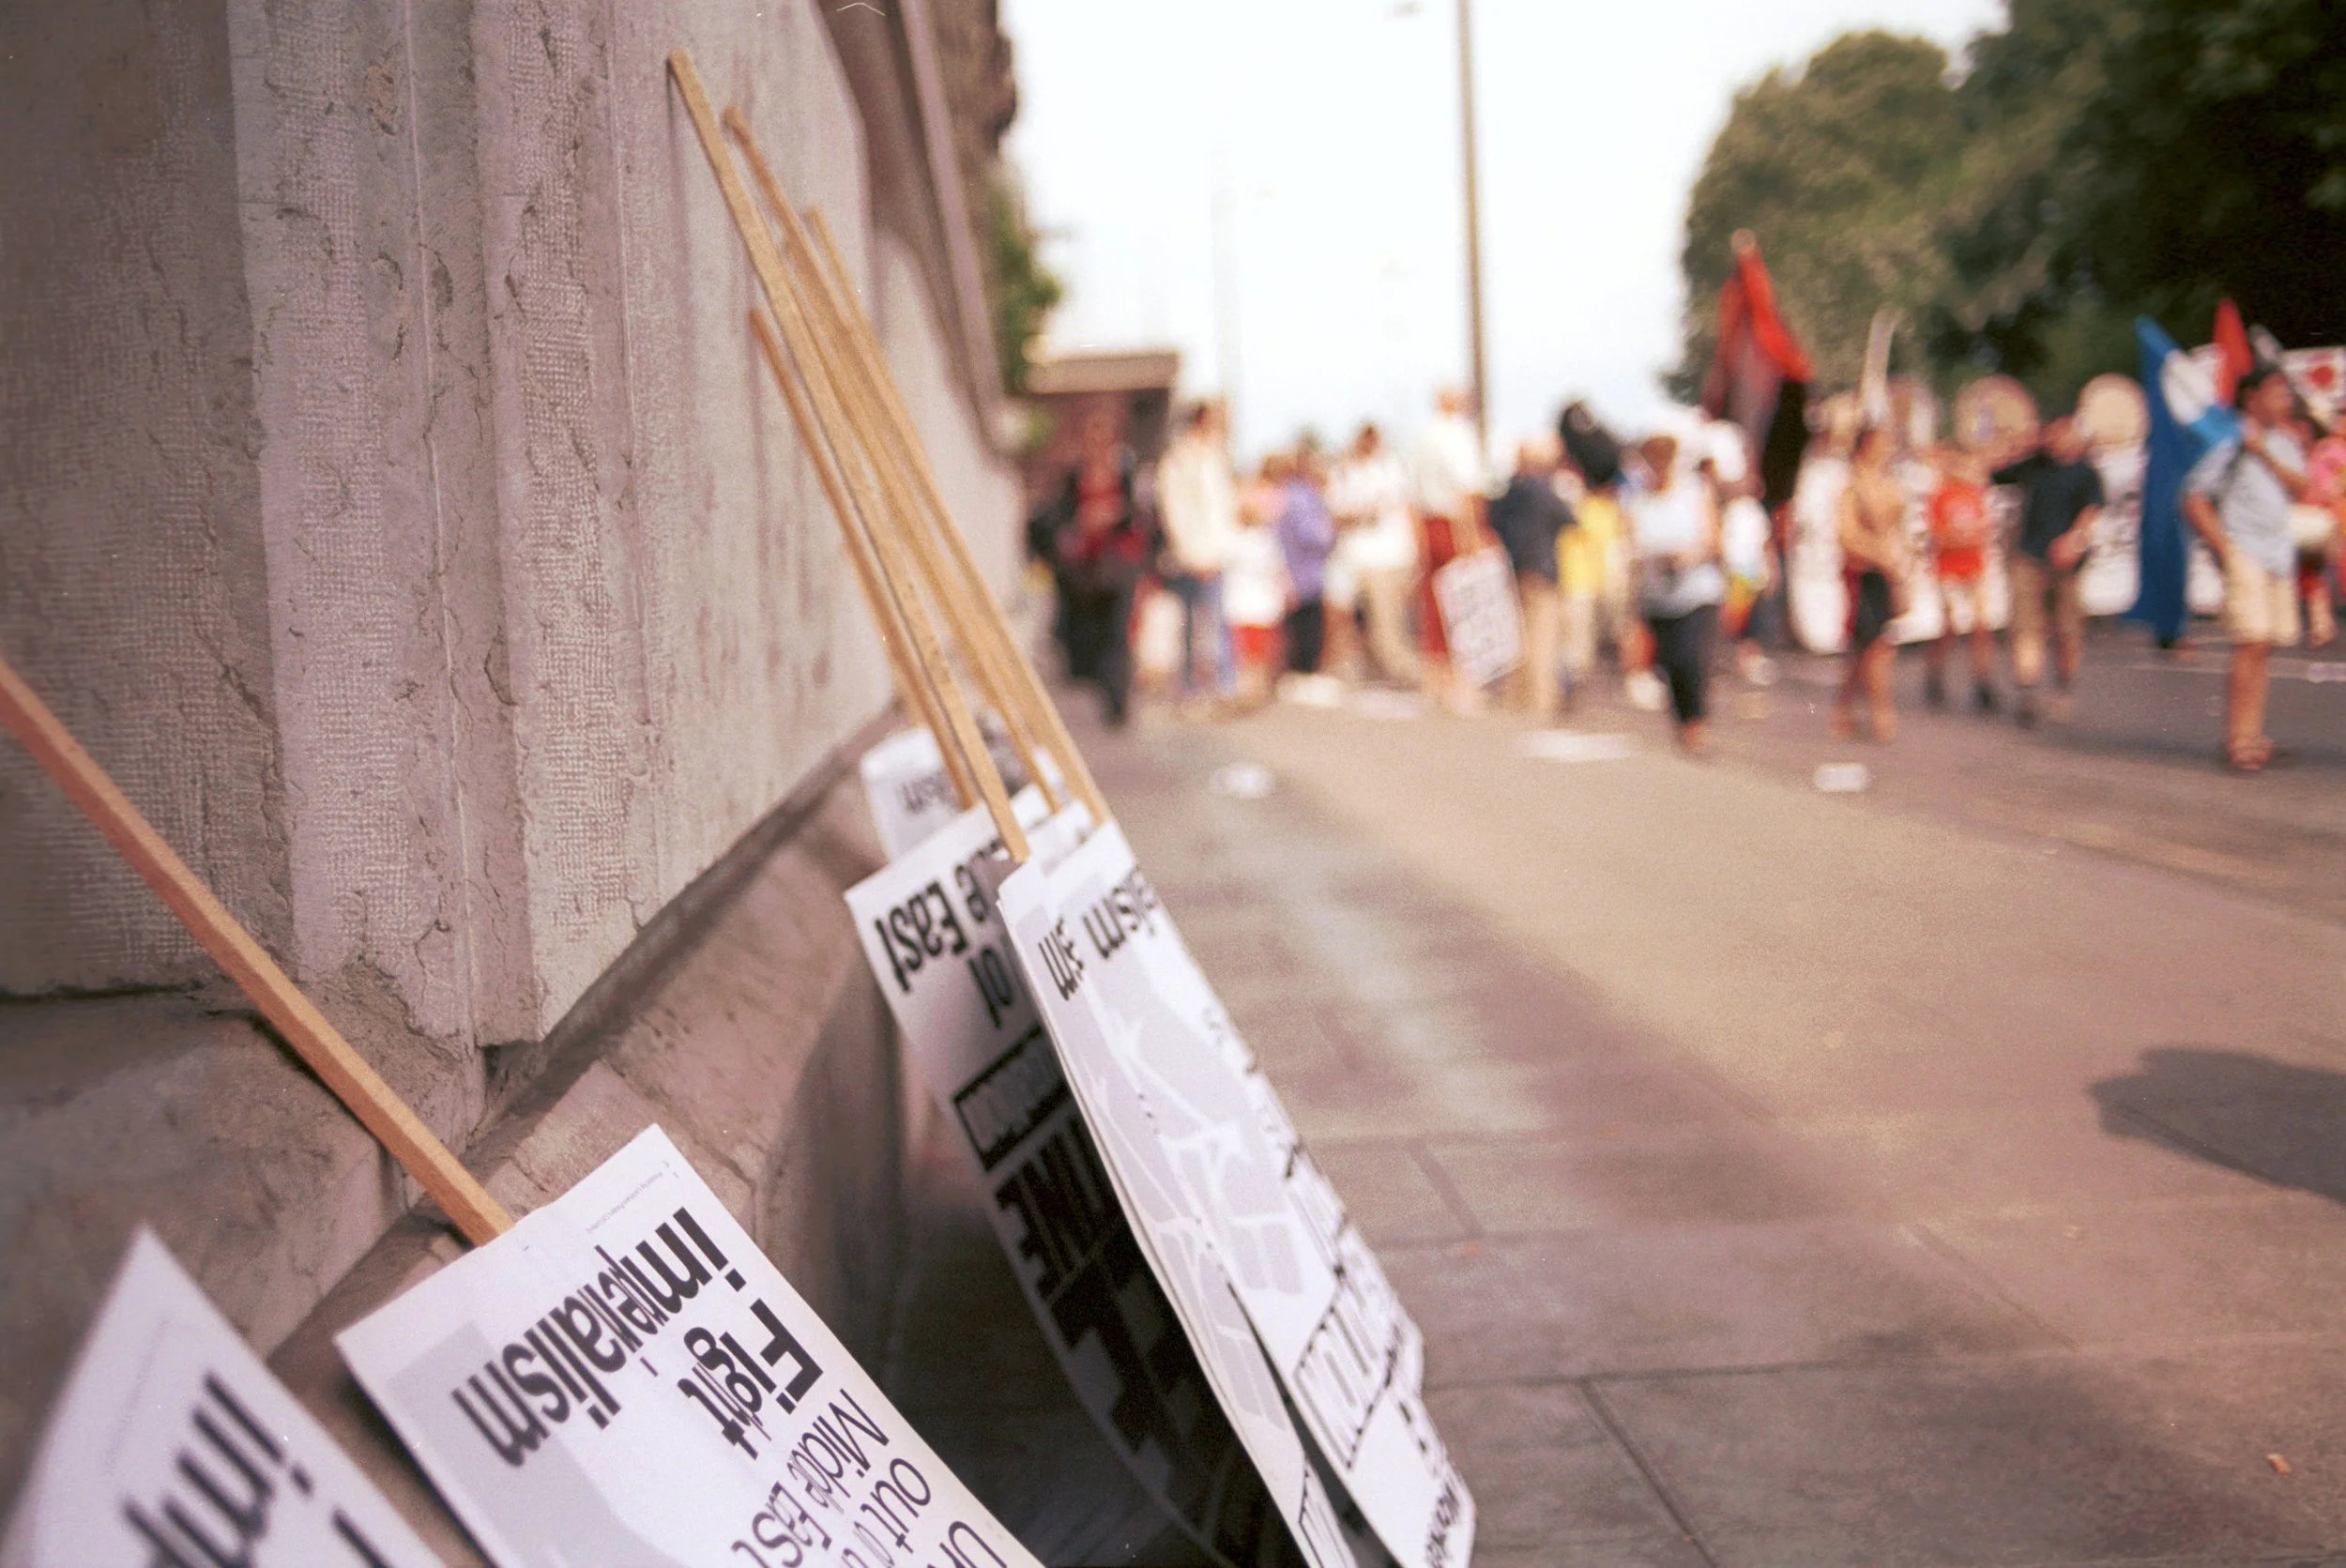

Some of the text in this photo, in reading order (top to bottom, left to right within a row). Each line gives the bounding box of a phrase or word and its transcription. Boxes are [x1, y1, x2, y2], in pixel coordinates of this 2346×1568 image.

[874, 878, 967, 994] East
[451, 1206, 747, 1468] imperialism
[677, 1297, 824, 1461] Fight
[786, 1388, 891, 1515] Middle
[859, 1457, 931, 1554] out
